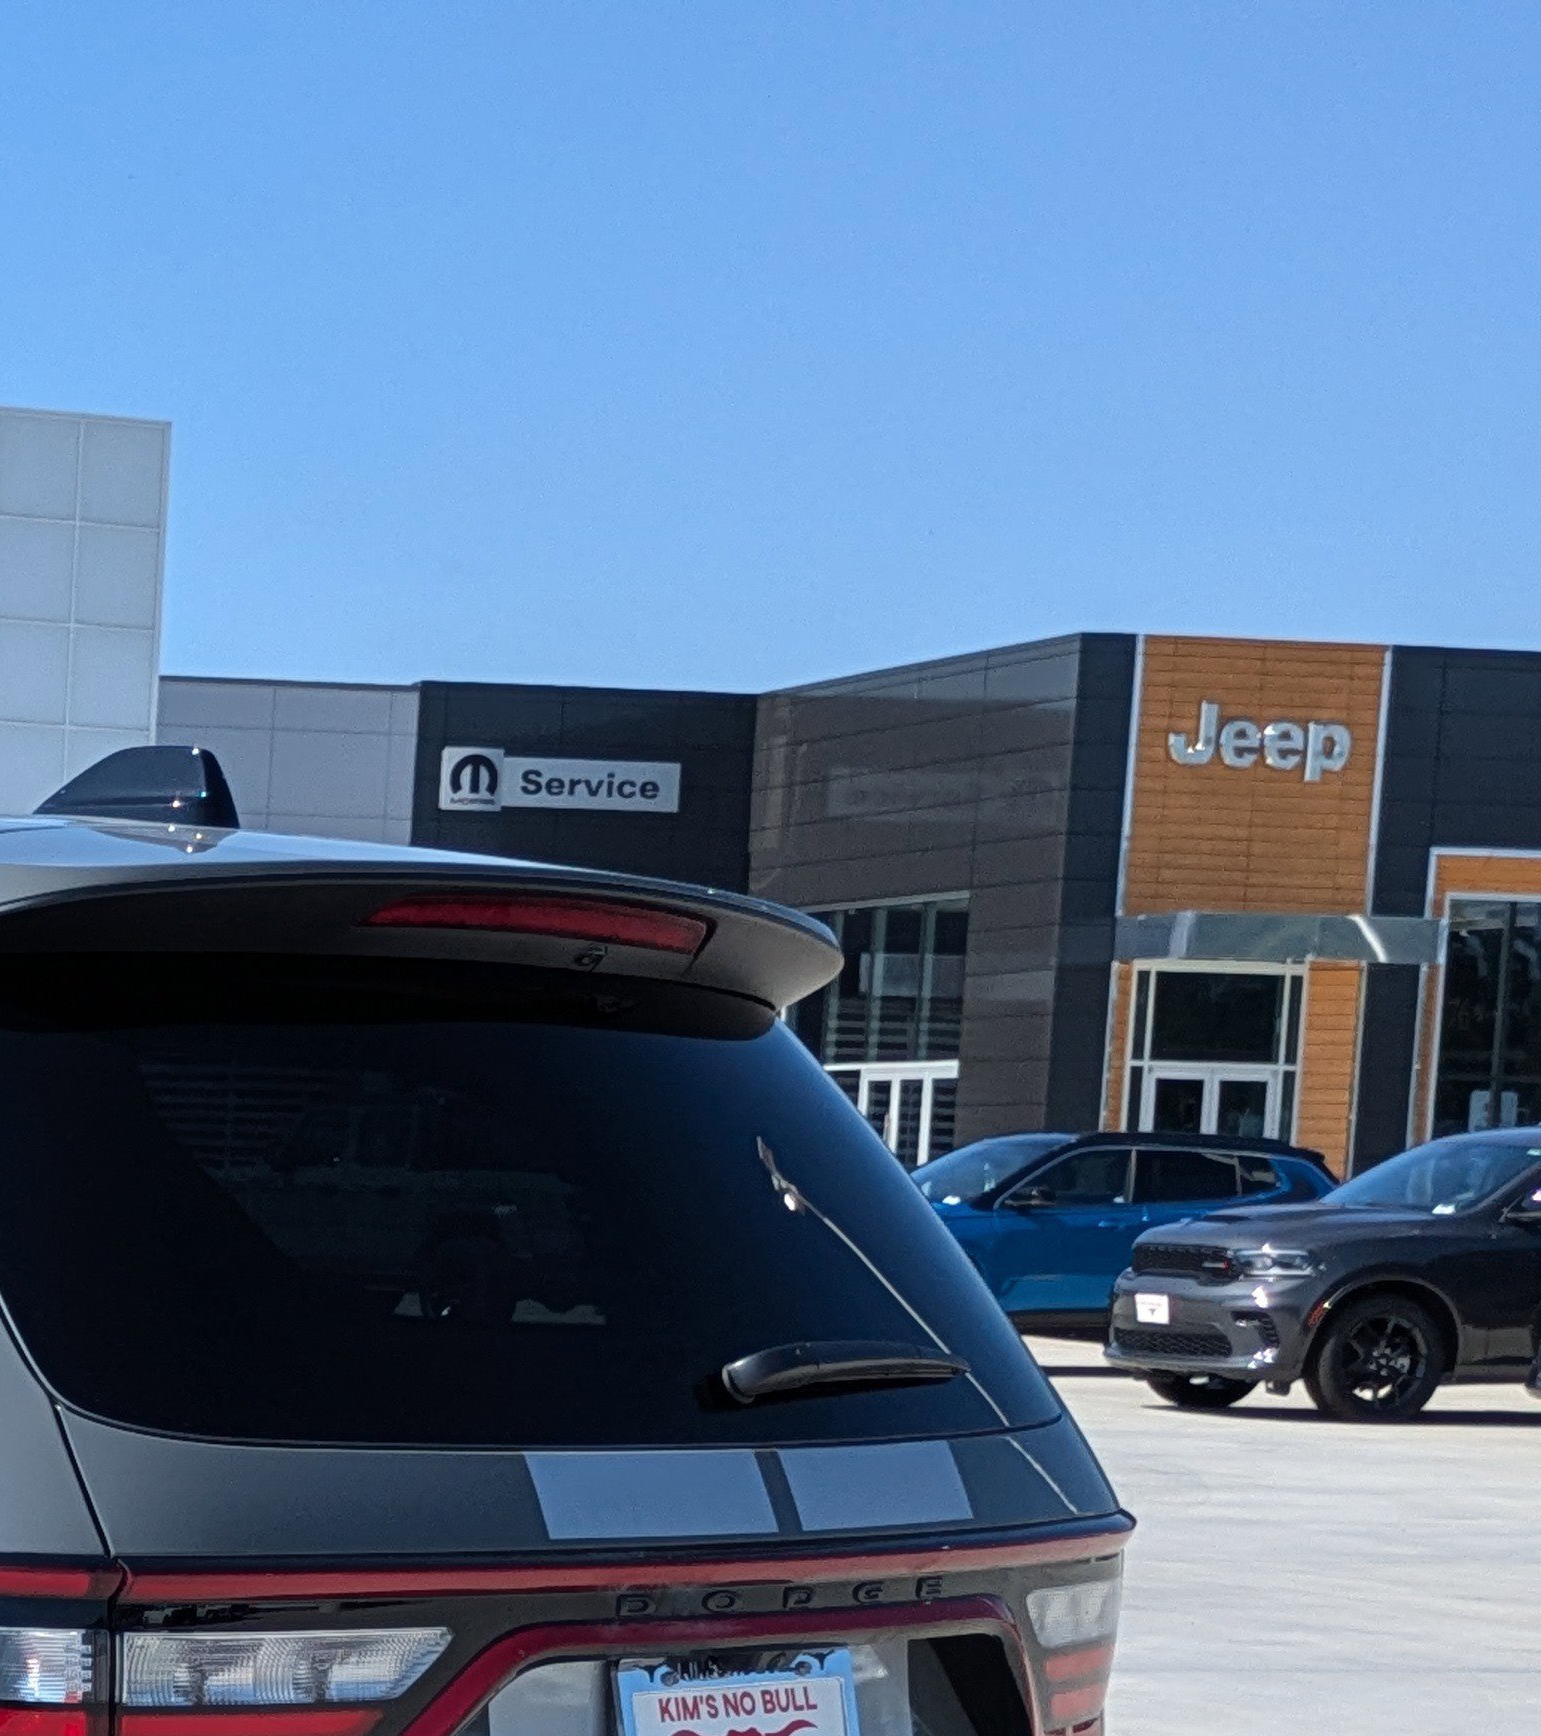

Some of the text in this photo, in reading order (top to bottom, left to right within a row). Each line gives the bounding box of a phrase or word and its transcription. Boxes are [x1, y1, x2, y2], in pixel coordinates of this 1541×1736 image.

[1168, 701, 1351, 783] Jeep
[520, 769, 660, 800] Service
[616, 1577, 943, 1620] DODGE
[658, 1685, 819, 1722] KIM'S NO BULL
